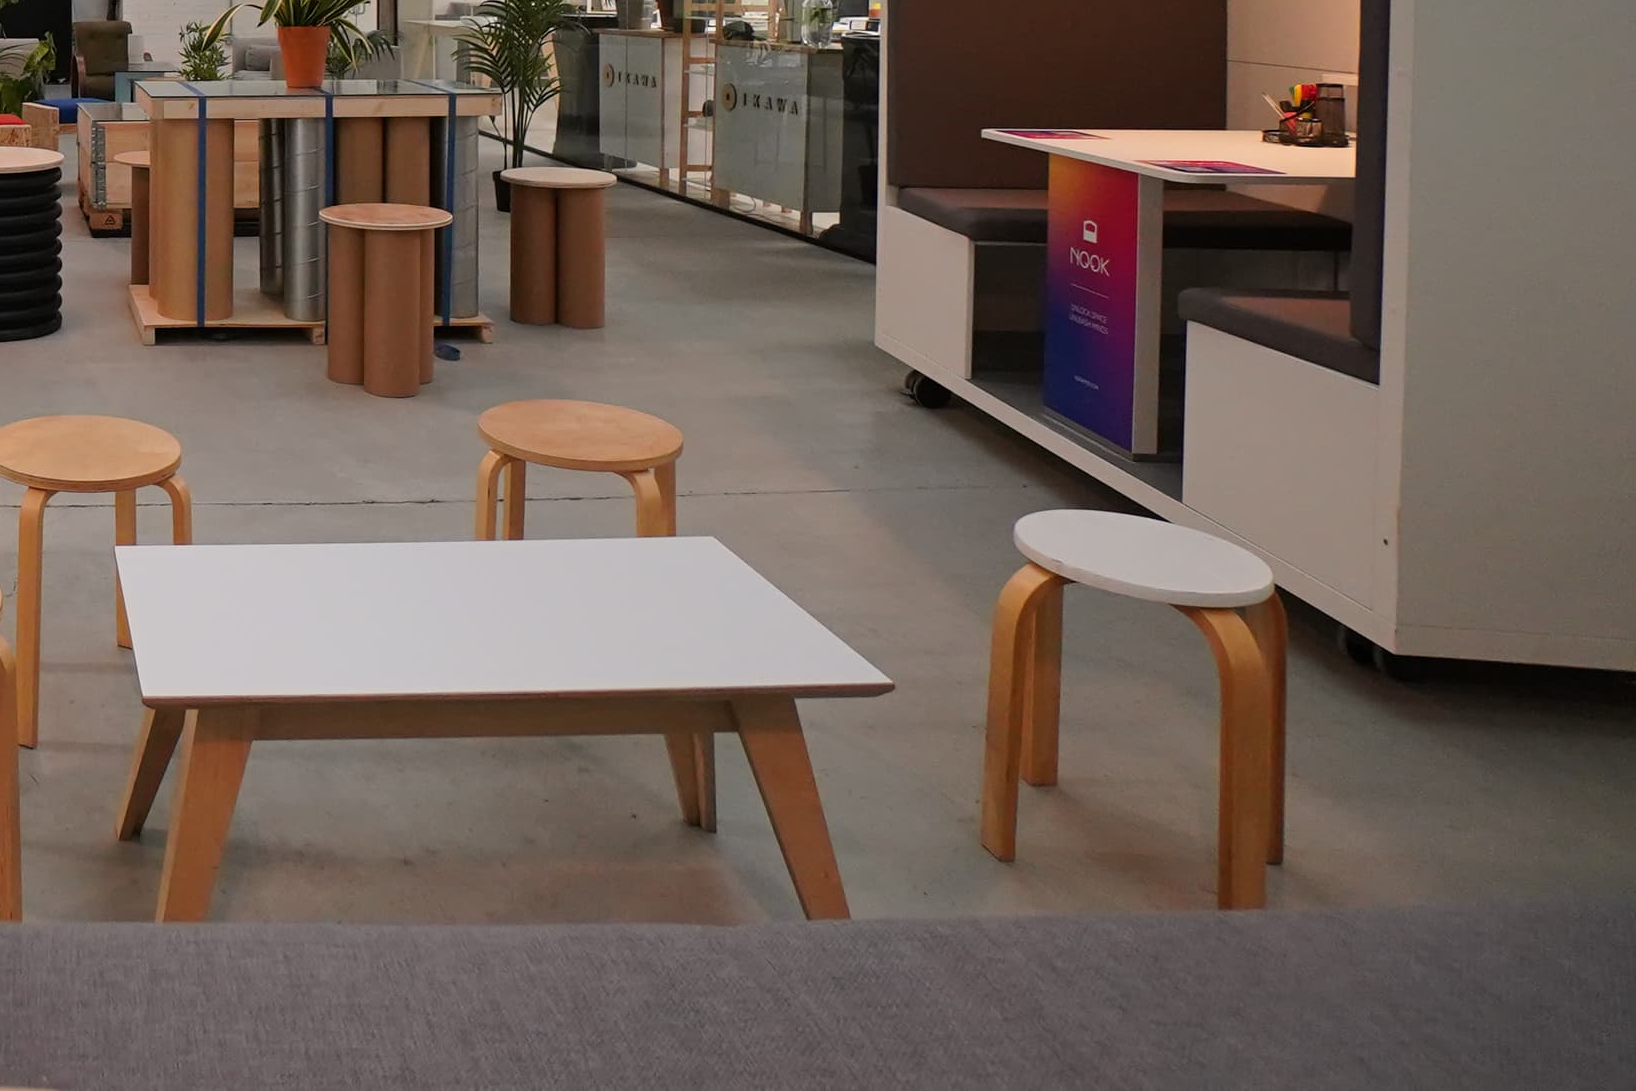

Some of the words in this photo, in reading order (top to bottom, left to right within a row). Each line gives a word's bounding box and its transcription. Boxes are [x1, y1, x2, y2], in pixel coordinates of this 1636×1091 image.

[617, 70, 658, 89] IKAWA
[742, 92, 799, 116] IKAWA
[1069, 246, 1111, 278] NOOK
